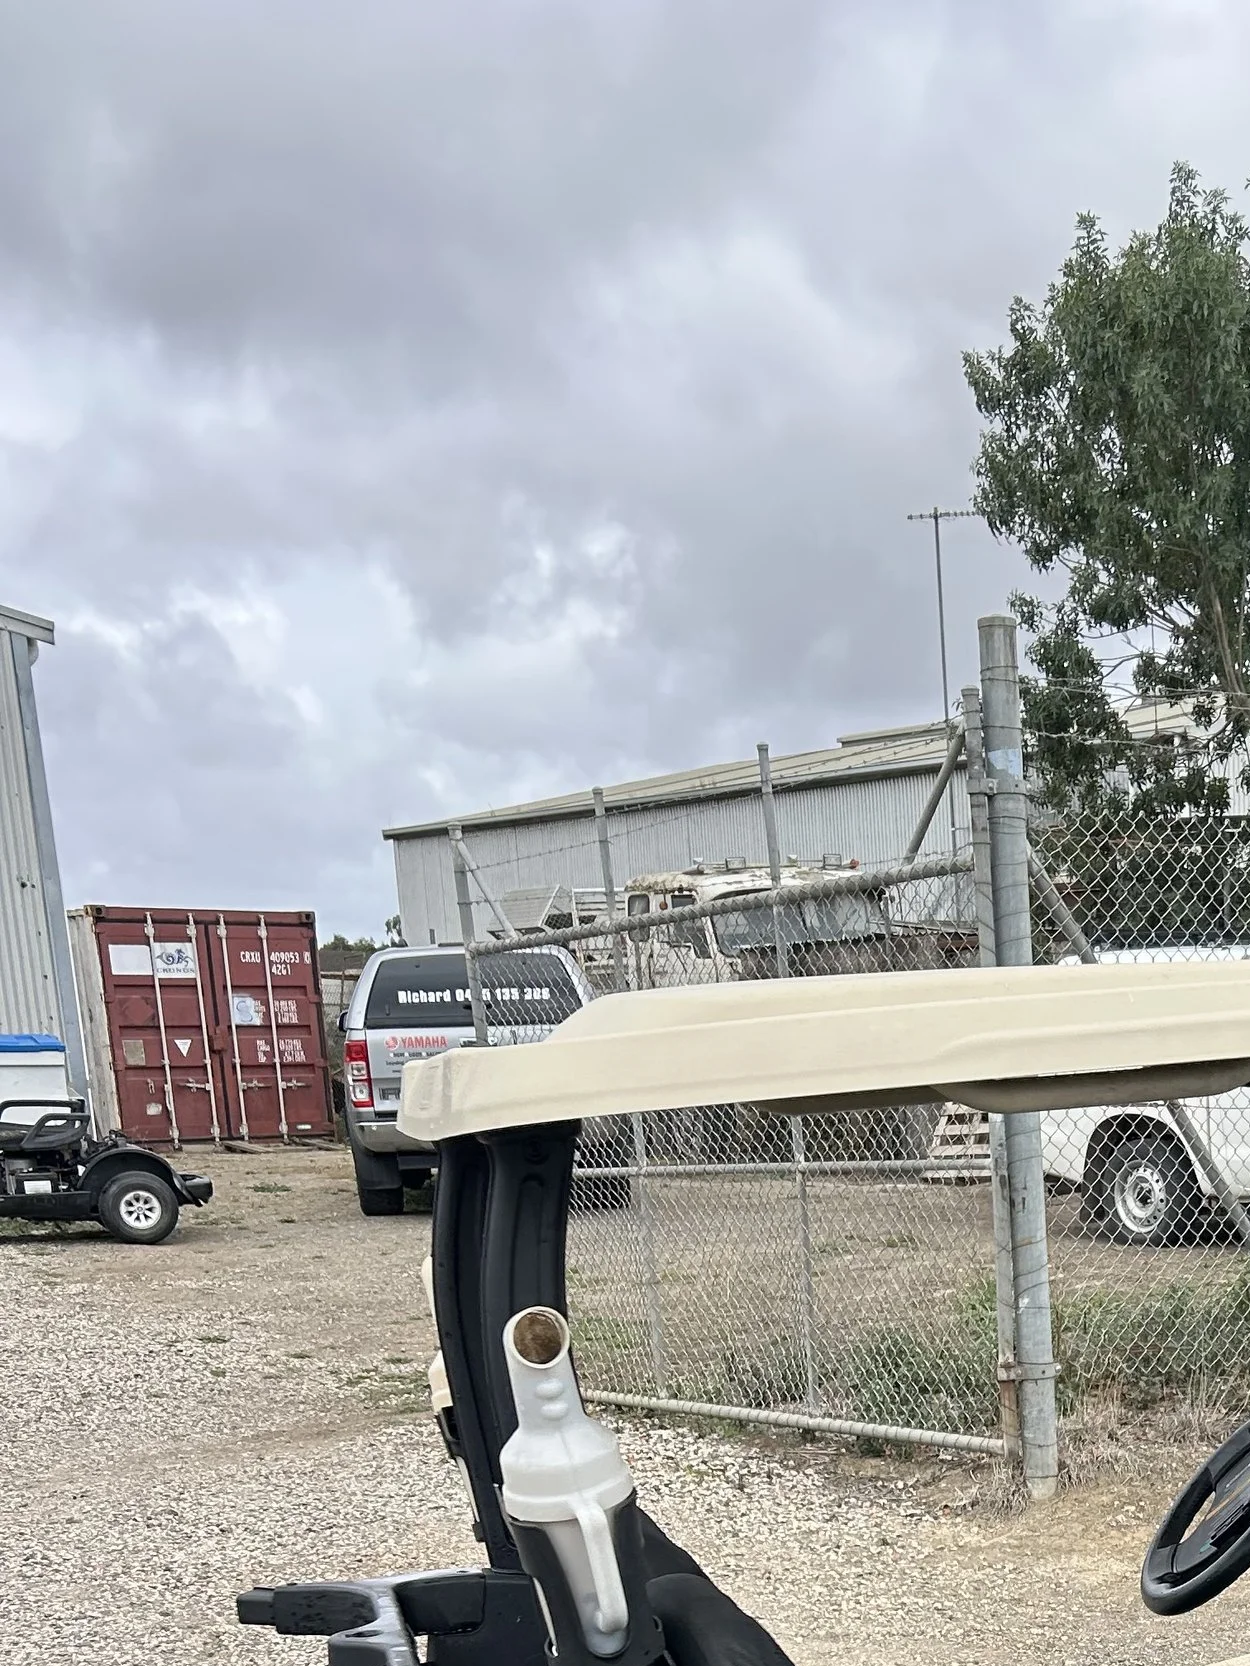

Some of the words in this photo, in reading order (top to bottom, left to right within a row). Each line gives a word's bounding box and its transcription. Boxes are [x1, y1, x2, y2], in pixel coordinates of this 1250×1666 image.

[240, 951, 261, 963] CRXU
[270, 951, 300, 963] 409053
[398, 989, 452, 1003] Richard
[401, 1036, 448, 1049] YAMAHA
